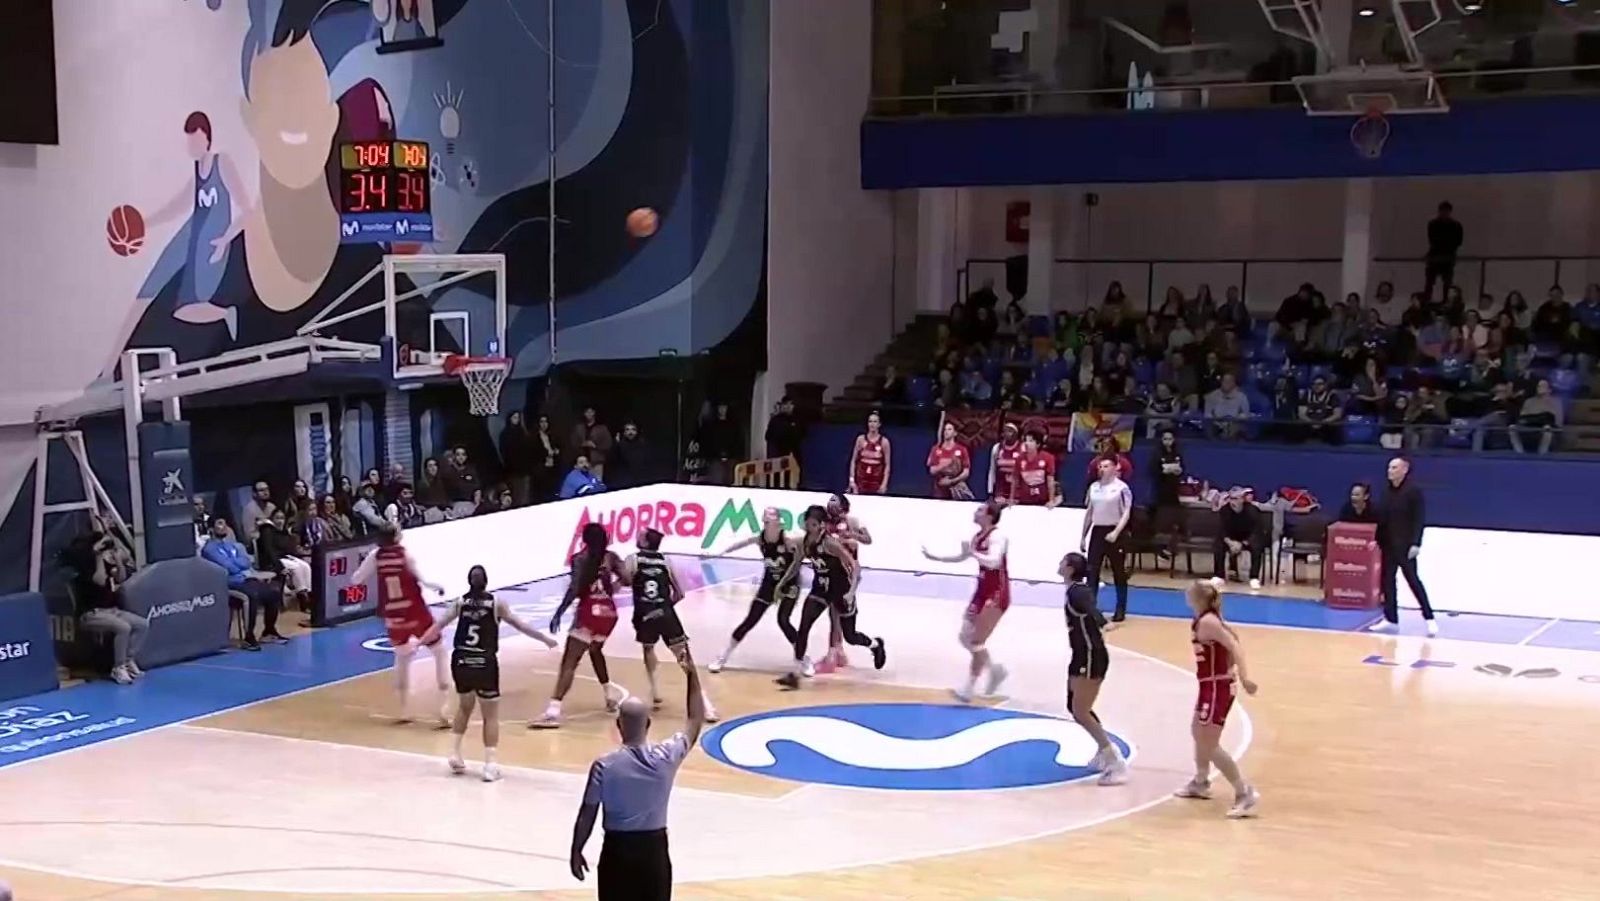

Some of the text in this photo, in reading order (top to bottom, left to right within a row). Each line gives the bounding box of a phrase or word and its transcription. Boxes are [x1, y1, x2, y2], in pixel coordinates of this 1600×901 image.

[354, 145, 390, 166] 7:04
[349, 173, 386, 211] 3.4
[465, 624, 480, 646] 5
